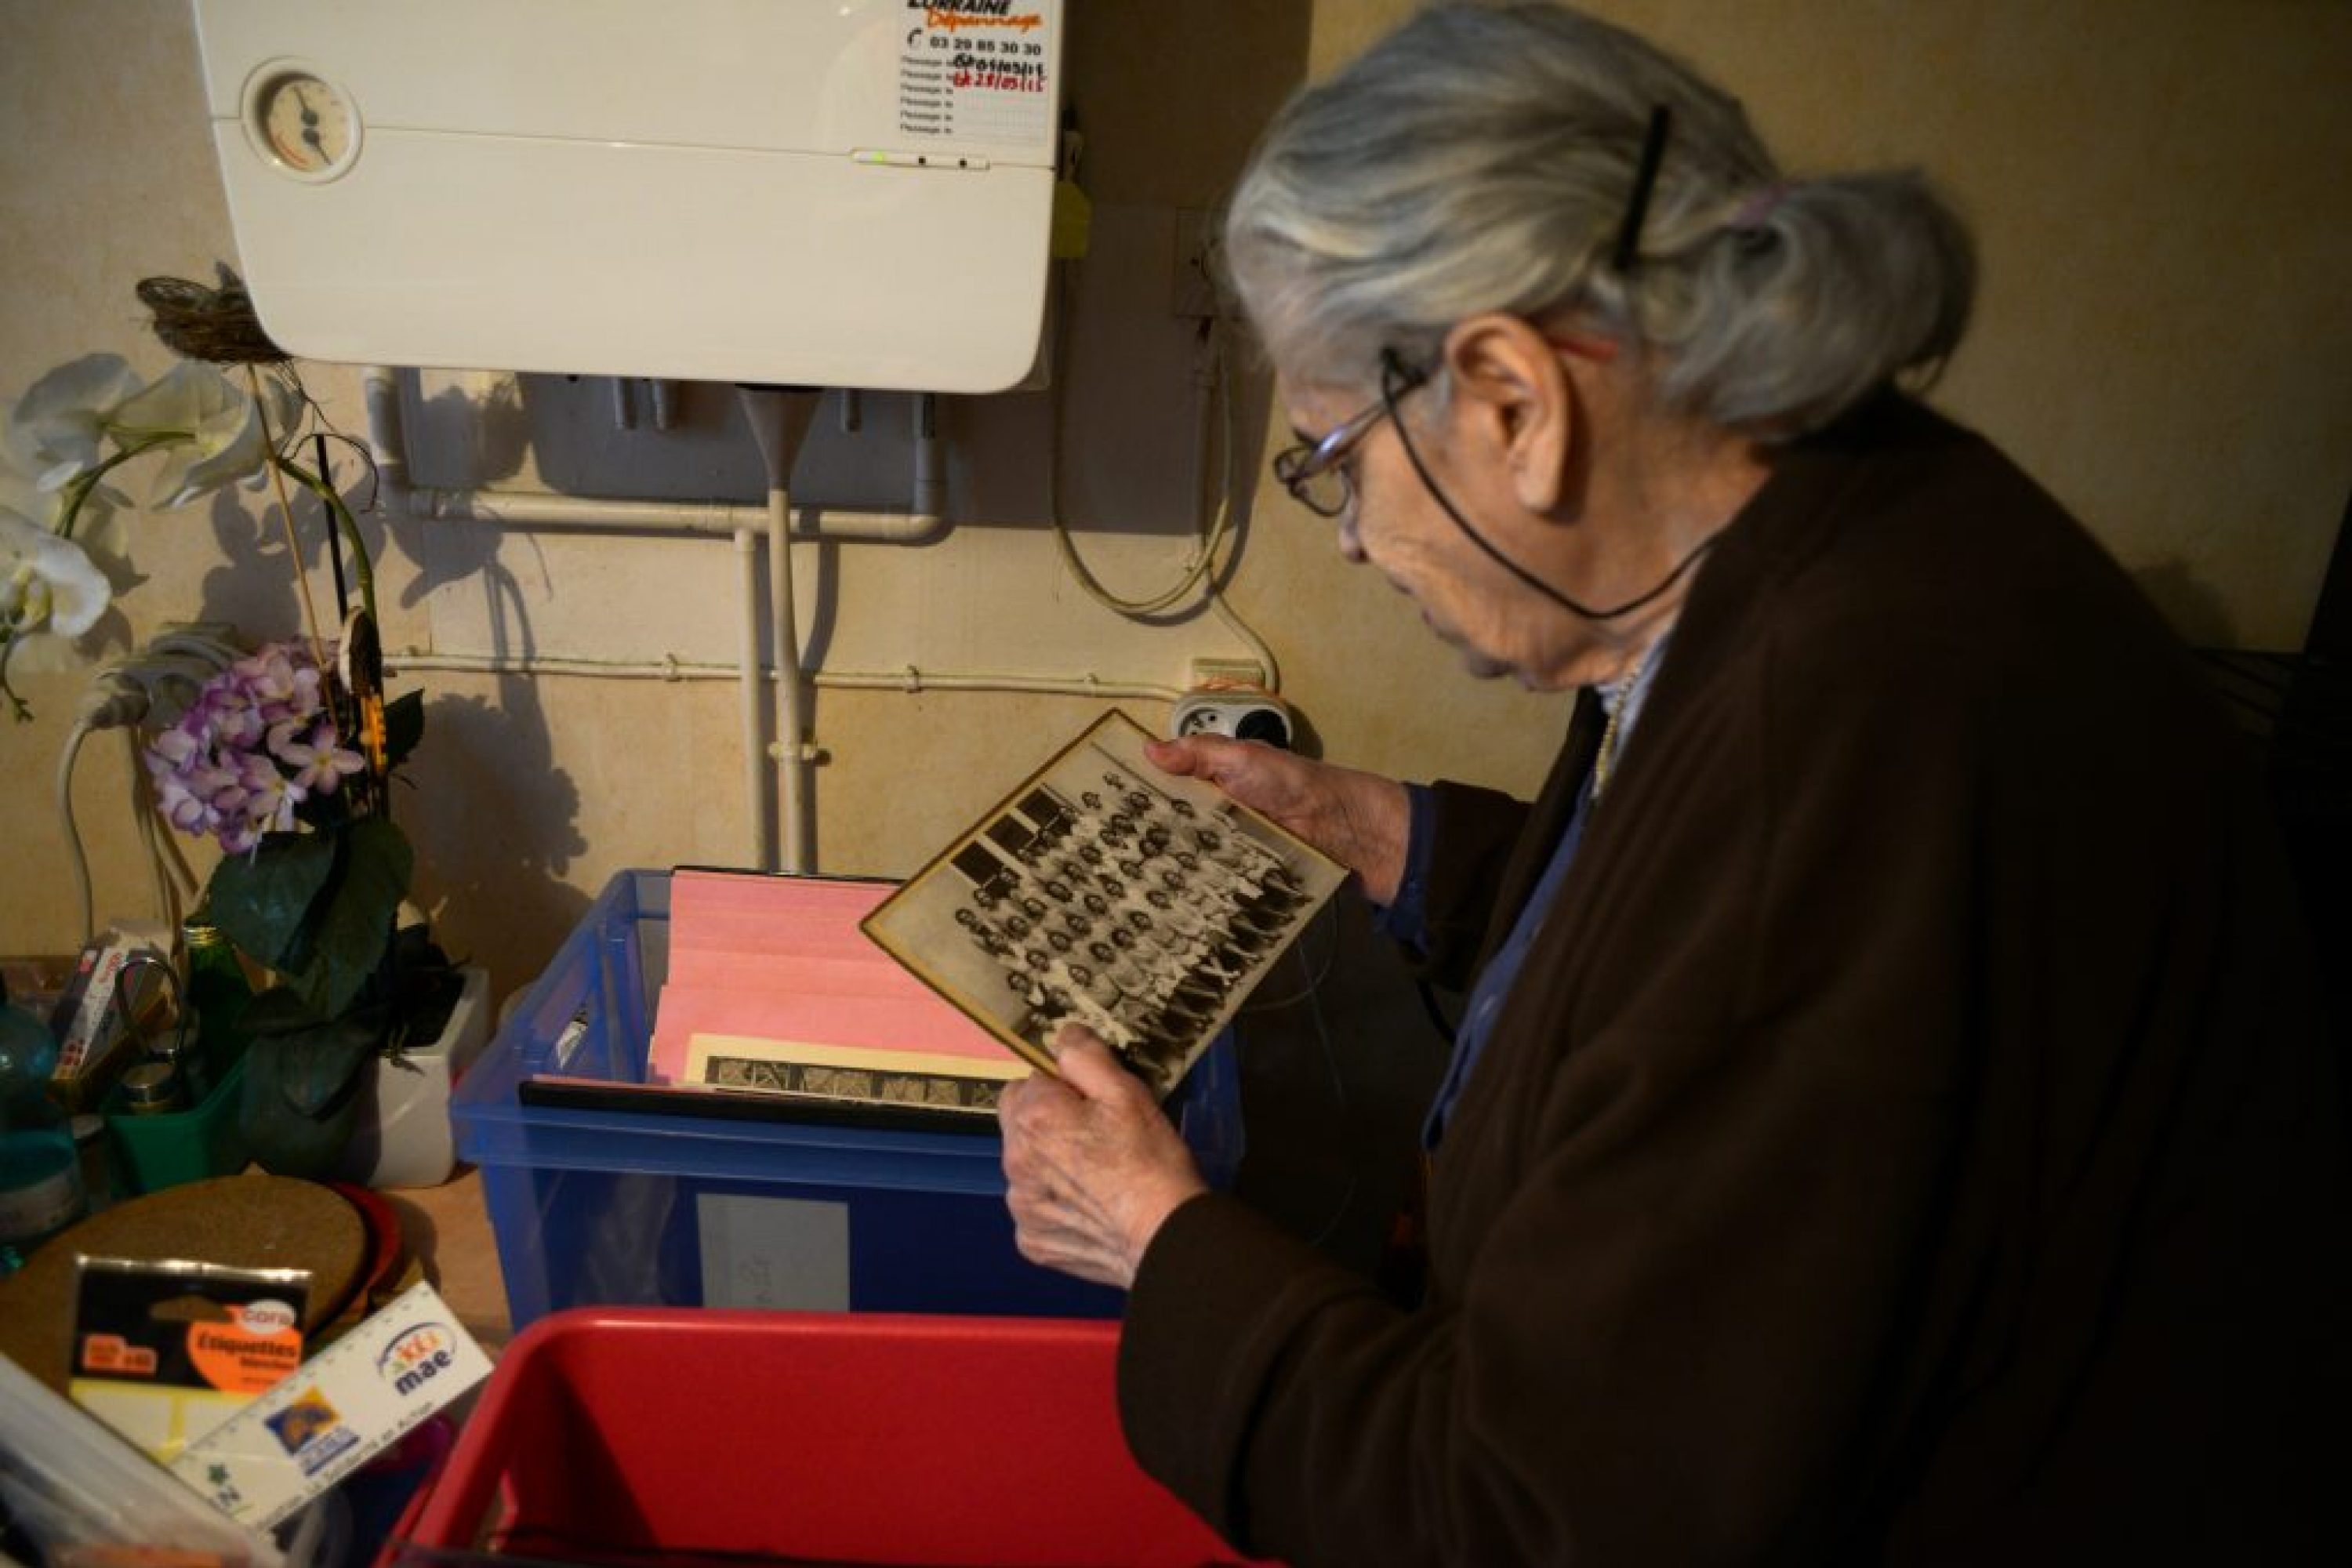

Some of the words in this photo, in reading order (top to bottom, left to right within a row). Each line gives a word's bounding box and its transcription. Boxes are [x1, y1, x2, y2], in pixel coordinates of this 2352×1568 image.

[929, 36, 949, 49] 03
[1000, 41, 1018, 55] 30
[1022, 42, 1041, 56] 30
[394, 1349, 452, 1396] mae
